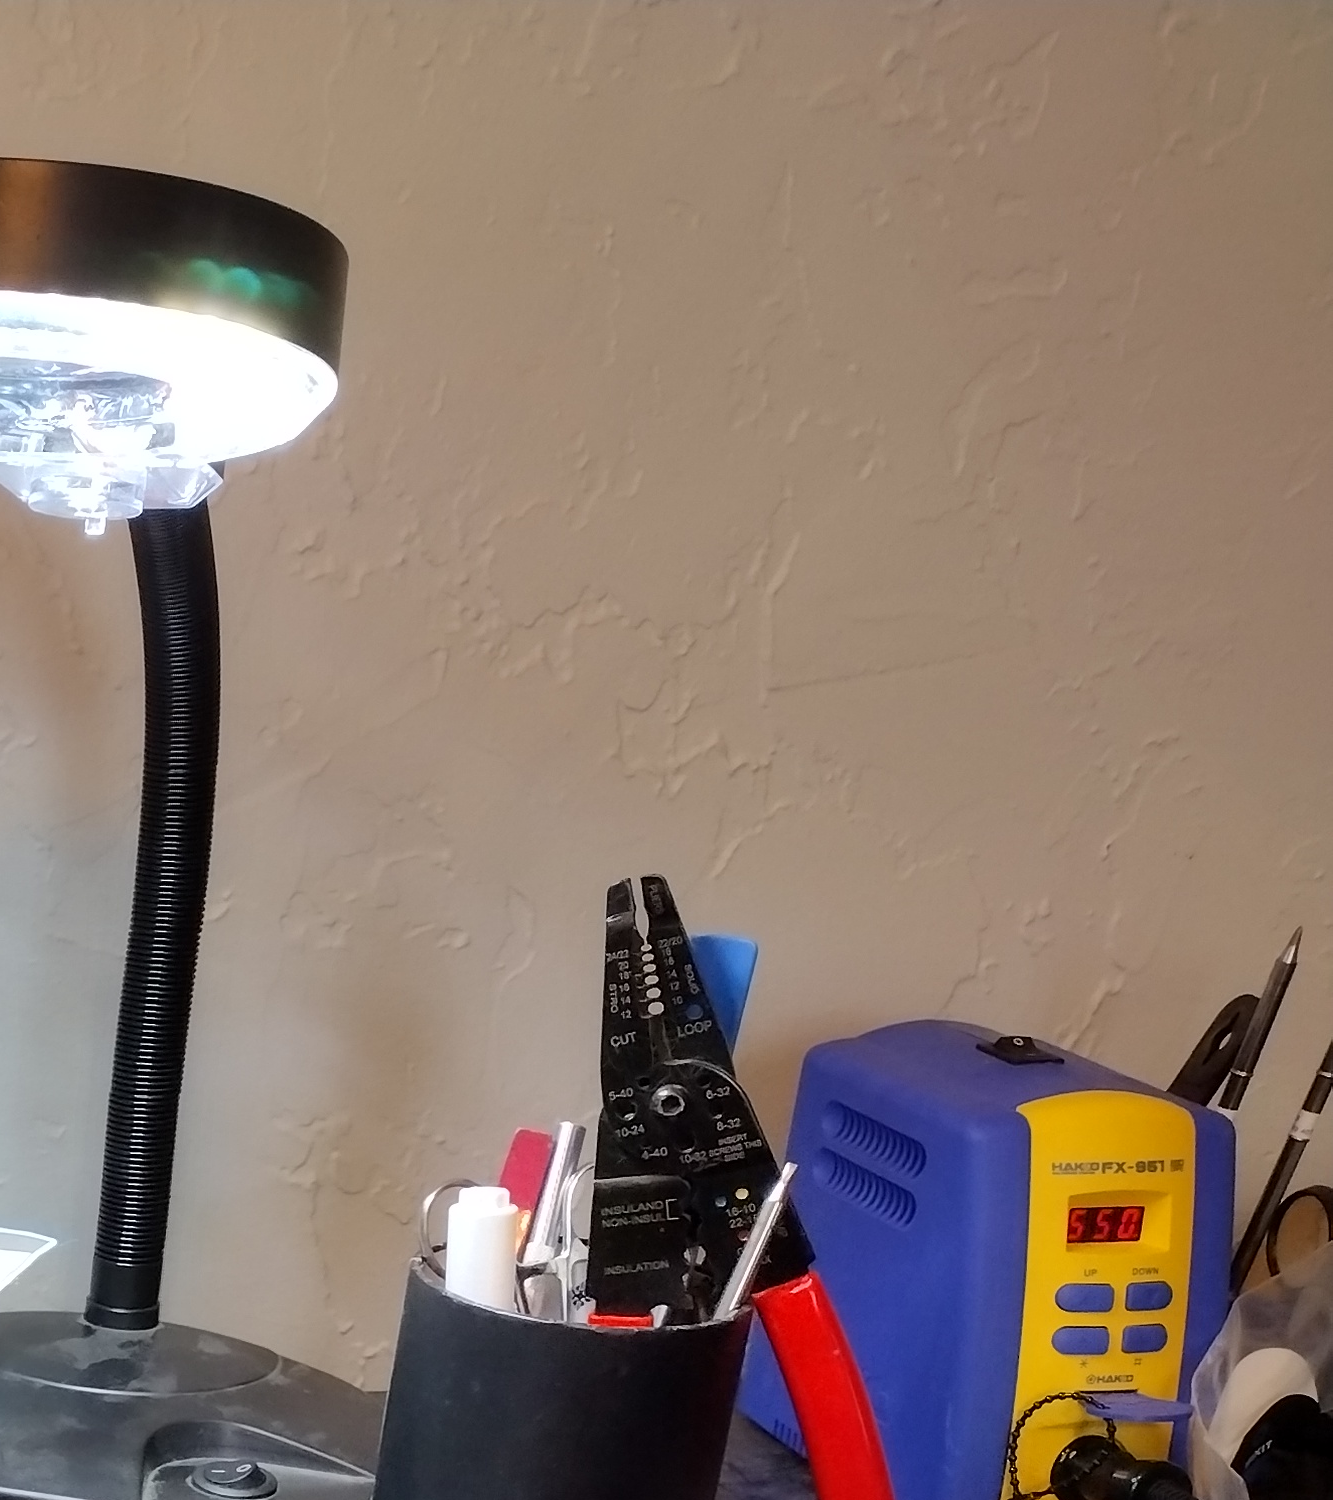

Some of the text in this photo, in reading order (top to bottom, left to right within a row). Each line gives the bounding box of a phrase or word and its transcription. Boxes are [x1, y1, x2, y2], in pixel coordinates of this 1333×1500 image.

[669, 981, 680, 991] 12
[684, 963, 700, 995] SOLID
[620, 996, 631, 1005] 14
[672, 995, 683, 1005] 10
[620, 1010, 632, 1020] 12
[677, 1020, 712, 1038] LOOP
[610, 1031, 637, 1048] CUT
[615, 1123, 645, 1138] 10-24
[641, 1146, 668, 1160] 4-40
[1101, 1160, 1165, 1174] FX-951
[604, 1260, 670, 1275] INSULATION
[1083, 1269, 1097, 1277] UP
[1132, 1267, 1159, 1276] DOWN
